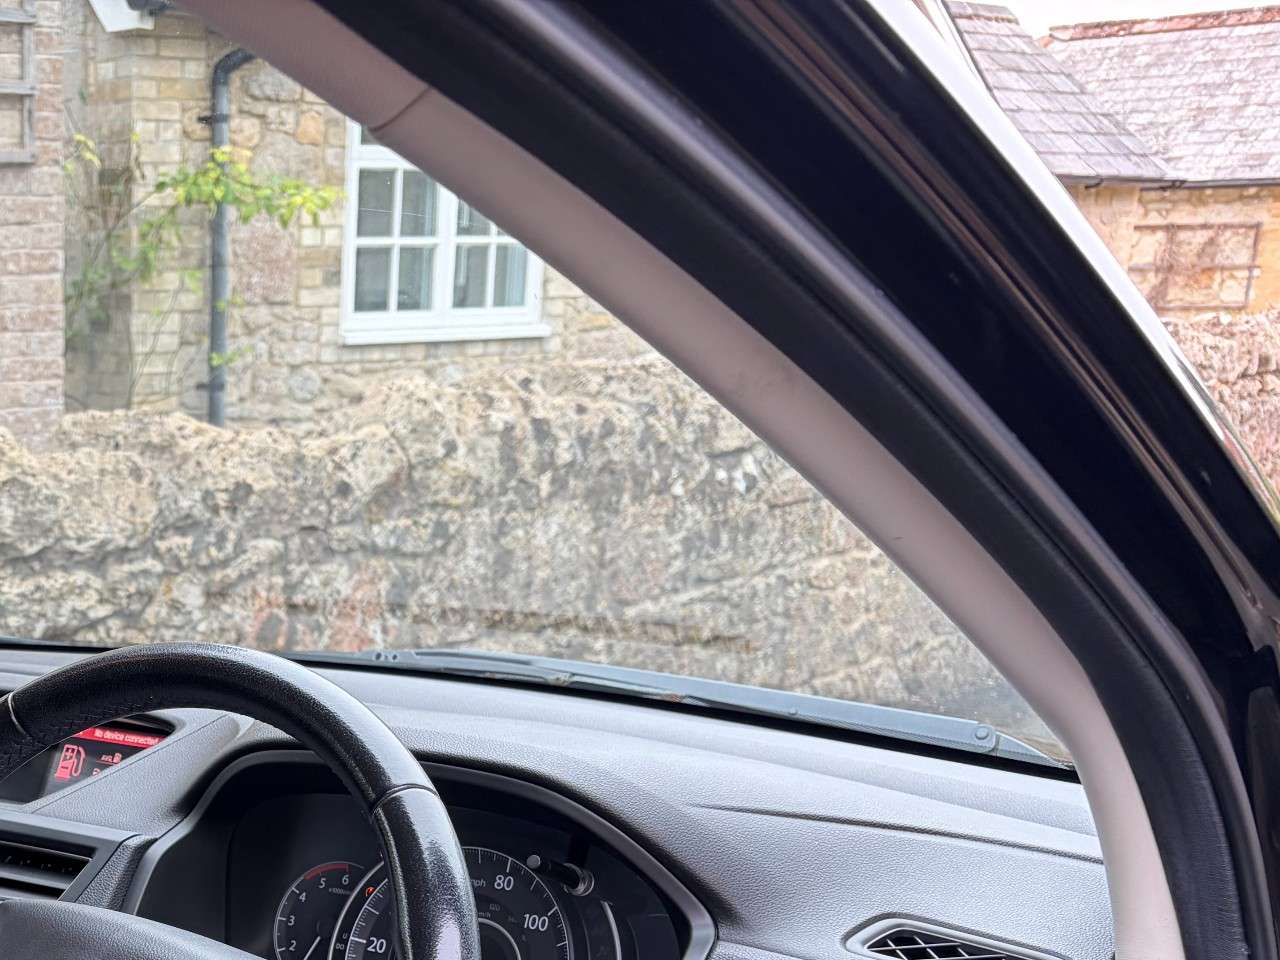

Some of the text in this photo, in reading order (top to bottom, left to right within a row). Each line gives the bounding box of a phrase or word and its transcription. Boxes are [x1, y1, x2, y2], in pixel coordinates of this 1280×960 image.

[103, 730, 124, 740] device
[125, 734, 160, 745] connected
[318, 878, 327, 889] 5
[342, 874, 350, 886] 6
[494, 874, 514, 891] 80
[299, 891, 307, 903] 4
[287, 915, 296, 927] 3
[523, 913, 549, 932] 100
[288, 940, 297, 952] 2
[367, 937, 387, 954] 20
